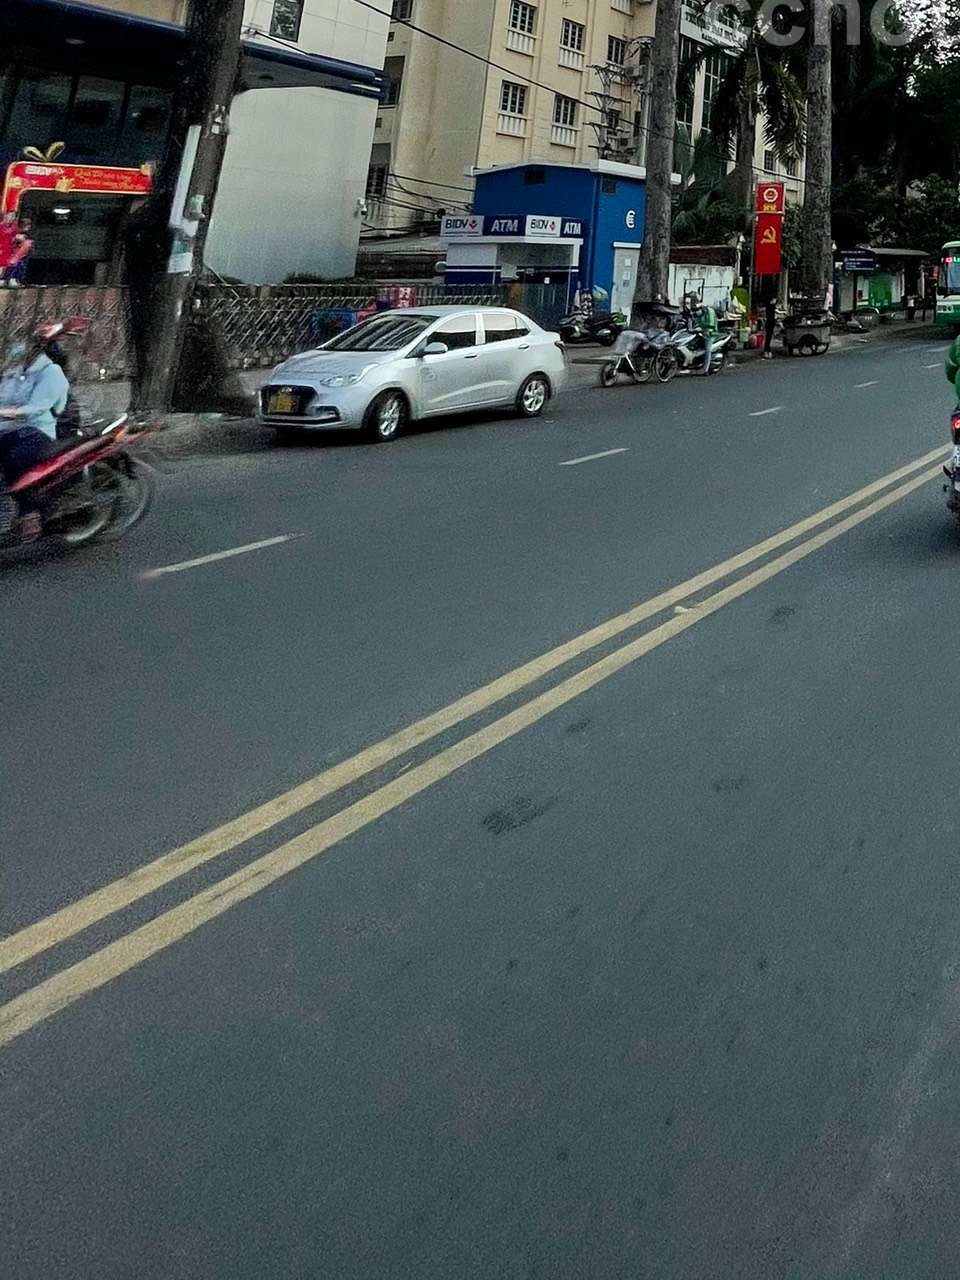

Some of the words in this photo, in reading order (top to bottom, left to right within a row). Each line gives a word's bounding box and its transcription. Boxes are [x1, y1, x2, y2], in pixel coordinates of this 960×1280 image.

[445, 219, 469, 229] BIDV
[491, 219, 518, 232] ATM
[530, 219, 549, 229] BIDV
[563, 222, 582, 234] ATM
